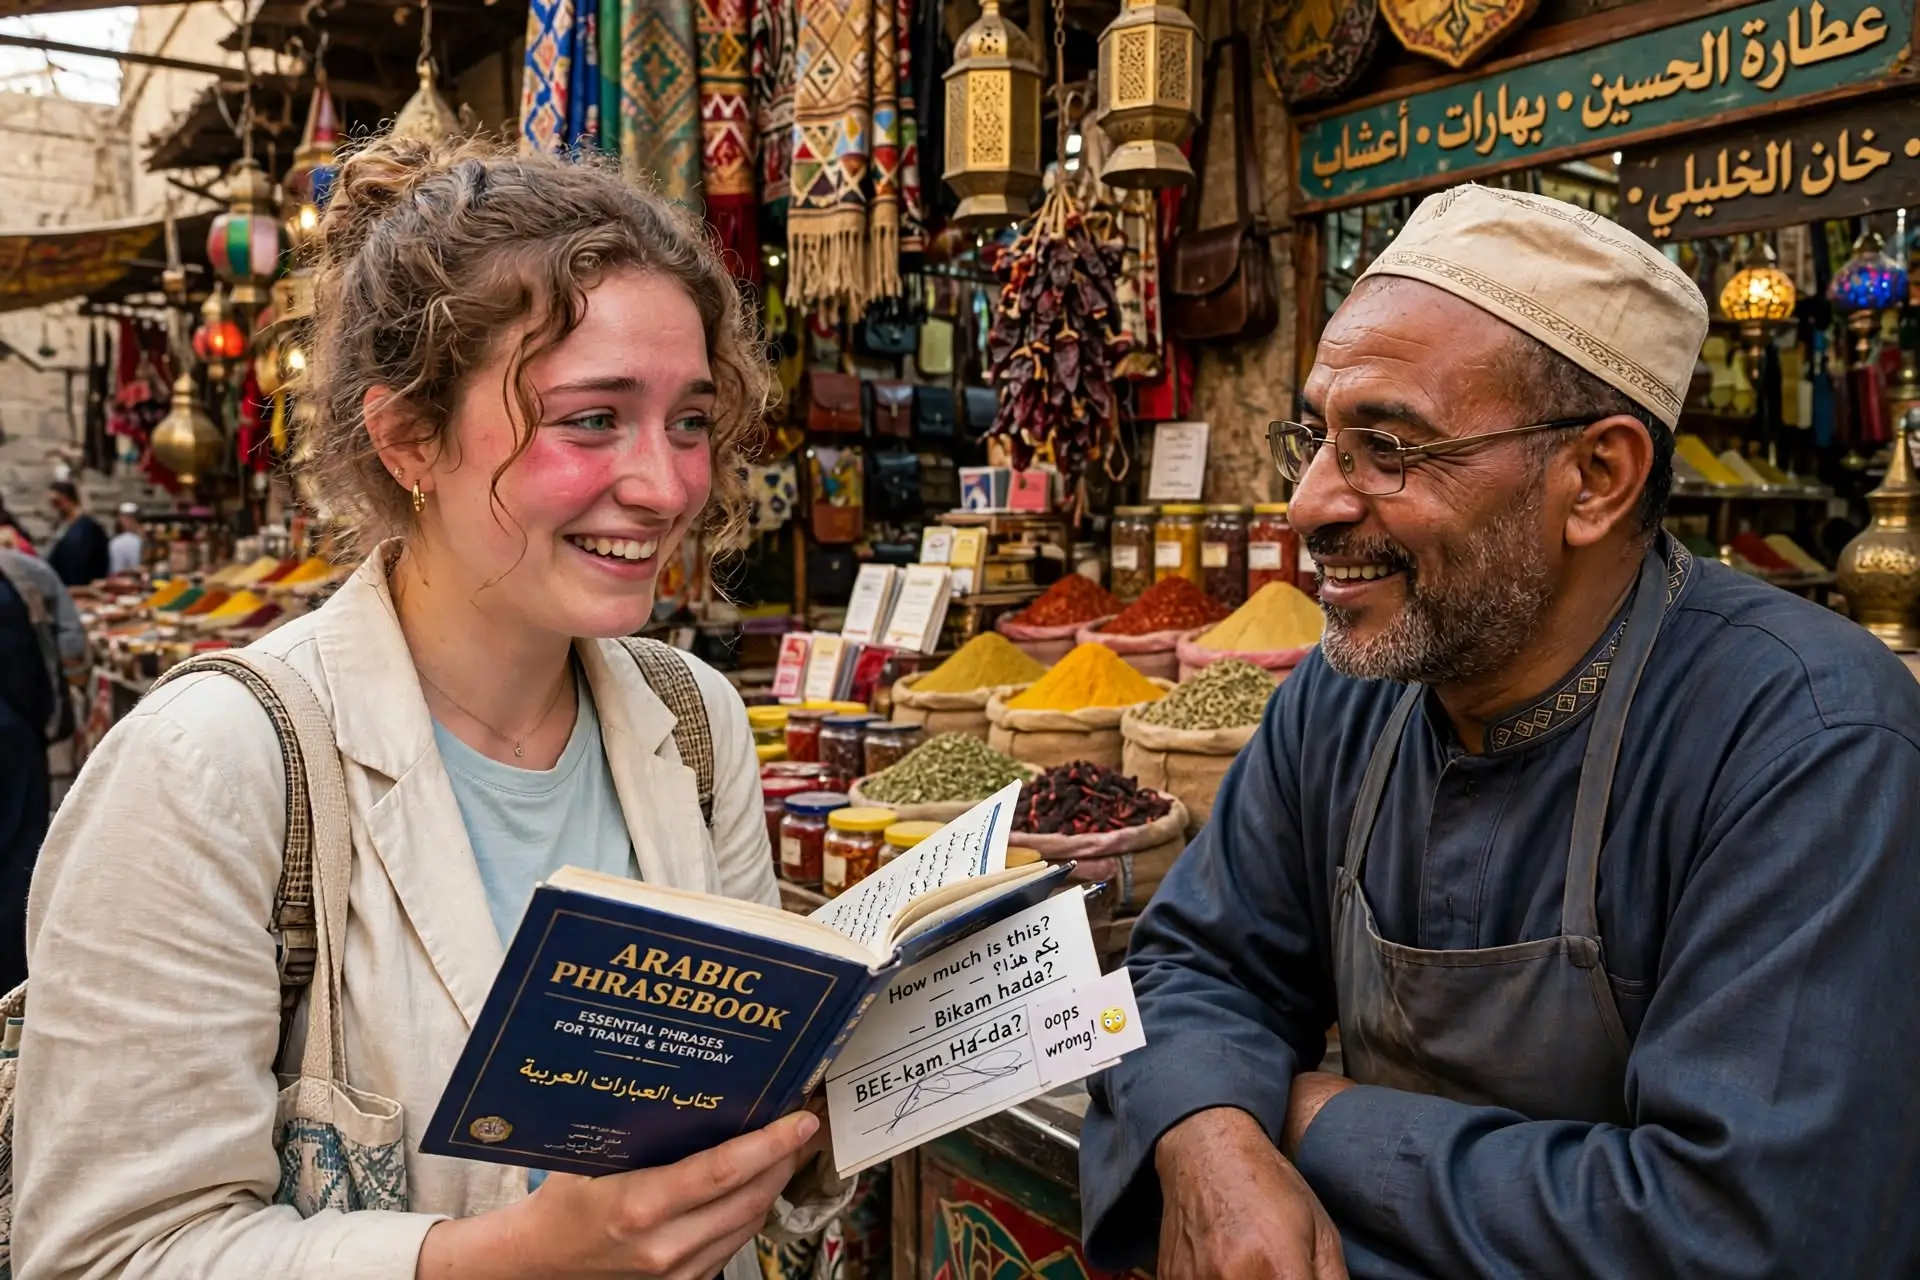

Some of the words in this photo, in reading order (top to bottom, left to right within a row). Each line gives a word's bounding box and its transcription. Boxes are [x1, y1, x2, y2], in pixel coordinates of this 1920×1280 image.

[1741, 0, 1888, 88] عطارة
[1581, 26, 1729, 128] الحسين
[1312, 101, 1409, 188] أعشاب
[1437, 83, 1545, 154] بهارات
[1801, 128, 1892, 196] خان
[1647, 139, 1792, 238] الخليلي
[609, 943, 763, 995] ARABIC
[888, 976, 927, 1004] How
[932, 951, 981, 983] much
[986, 941, 1001, 957] is
[1006, 915, 1050, 948] this?
[1035, 936, 1059, 963] بكم
[550, 961, 791, 1031] PHRASEBOOK
[935, 994, 992, 1028] Bikam
[998, 961, 1053, 999] hada?
[1044, 1004, 1079, 1030] oops
[554, 1021, 584, 1035] FOR
[588, 1027, 641, 1048] TRAVEL
[645, 1038, 656, 1050] &
[660, 1042, 734, 1065] EVERYDAY
[578, 1010, 655, 1037] ESSENTIAL
[659, 1026, 725, 1050] PHRASES
[1045, 1020, 1097, 1058] wrong!
[519, 1057, 588, 1086] العربية
[590, 1075, 670, 1103] العبارات
[856, 1054, 943, 1104] BEE-kam
[672, 1092, 724, 1110] كتاب
